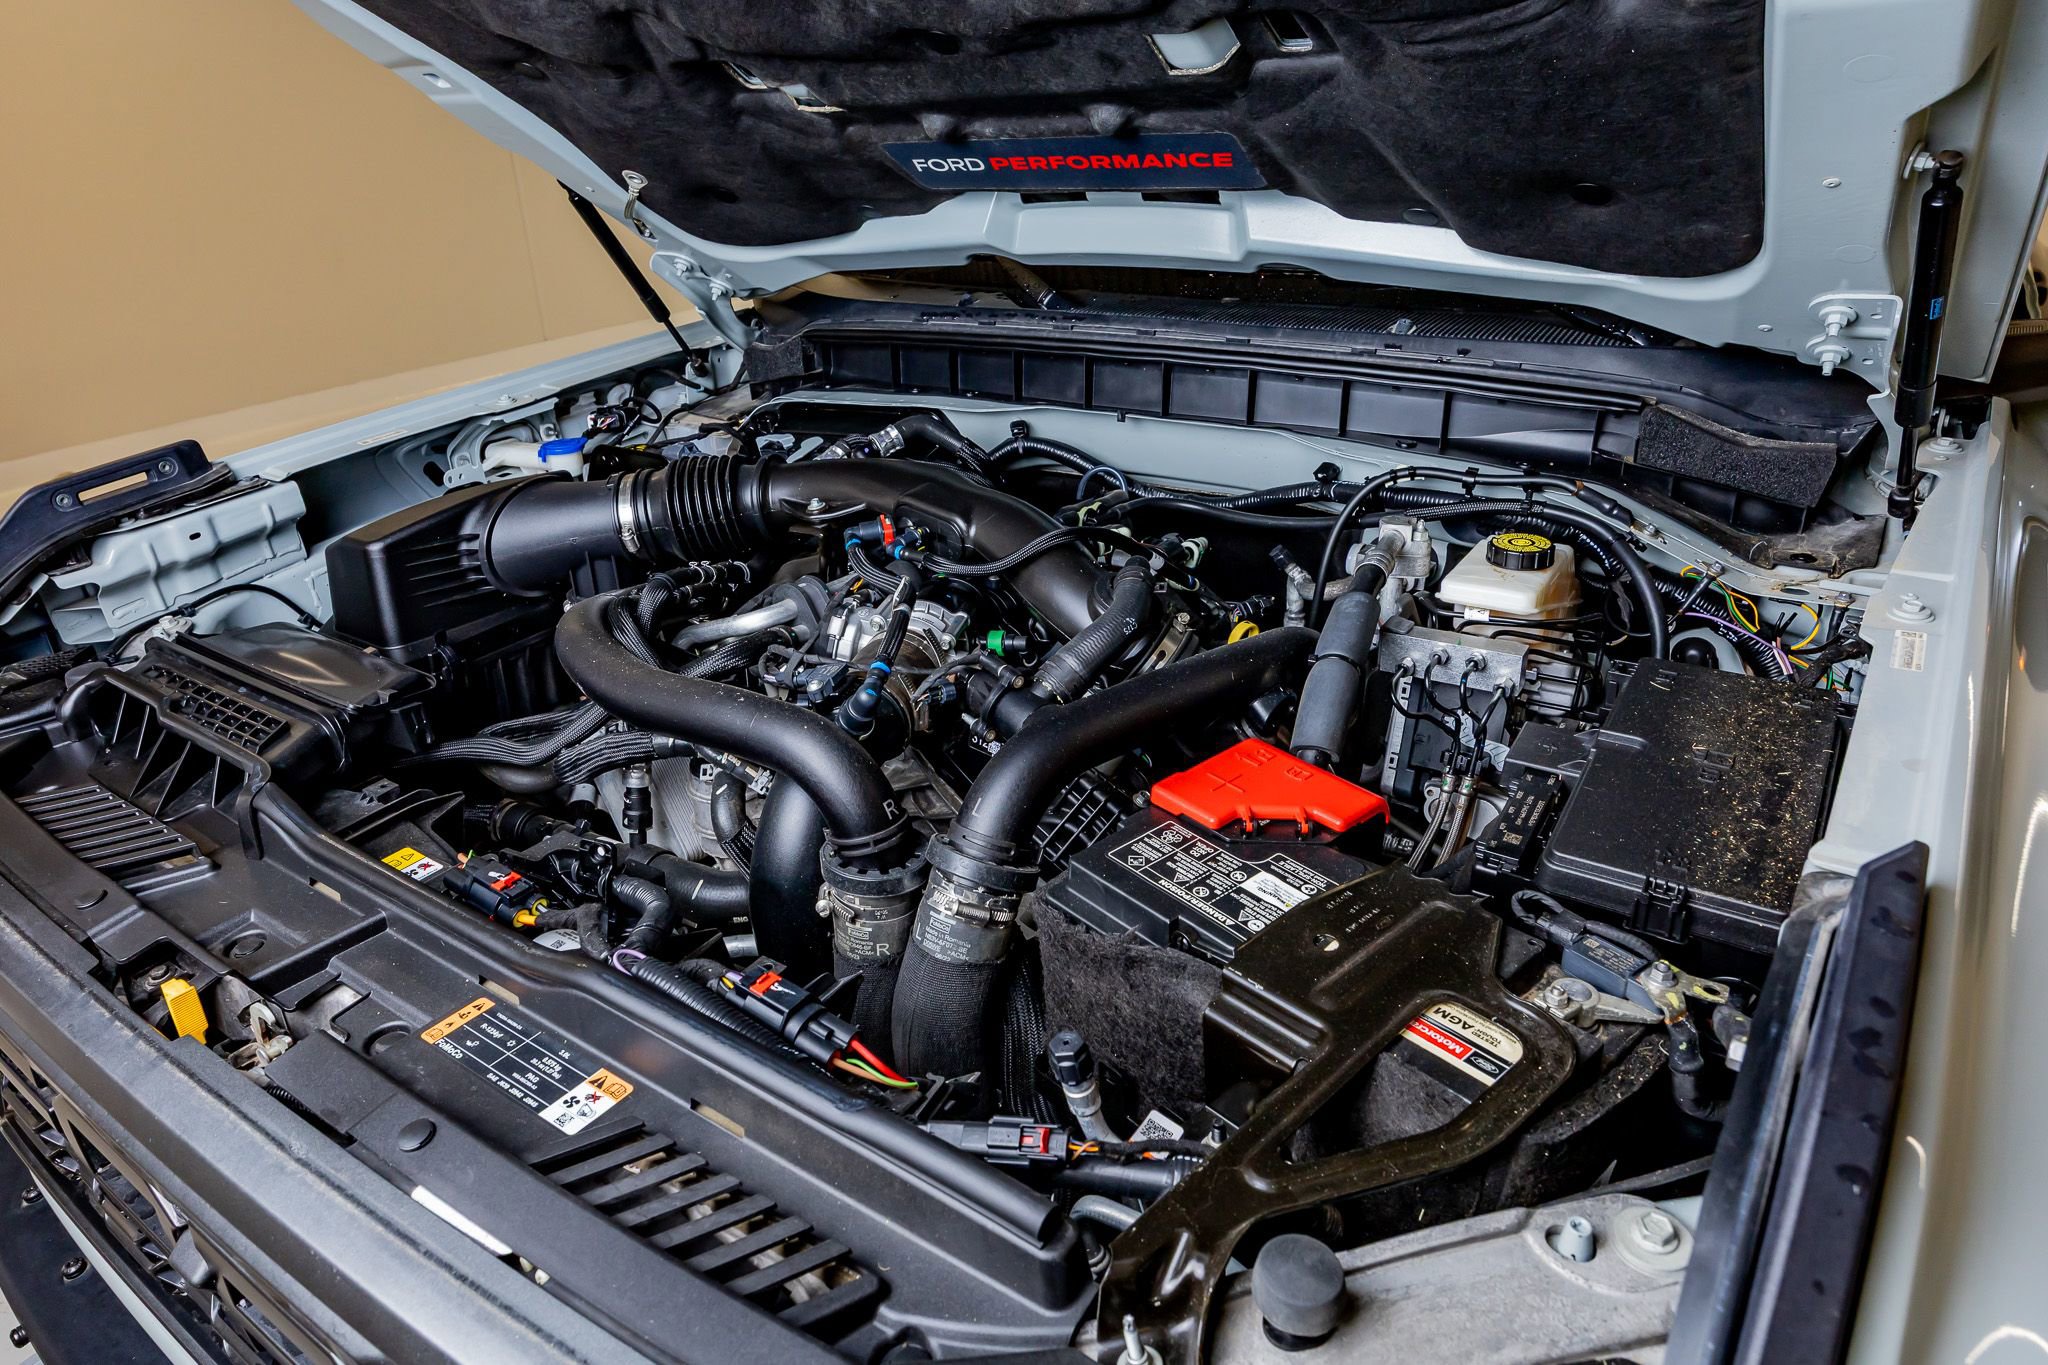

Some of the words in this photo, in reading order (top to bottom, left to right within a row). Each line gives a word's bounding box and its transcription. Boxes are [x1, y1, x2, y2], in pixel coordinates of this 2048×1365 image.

[911, 158, 985, 173] FORD
[990, 152, 1233, 171] PERFORMANCE
[882, 798, 900, 821] R
[971, 797, 981, 817] L
[1192, 846, 1207, 855] NOT
[1158, 879, 1227, 922] DANGER/POISON
[915, 922, 922, 941] L
[876, 943, 891, 956] R
[1433, 1007, 1475, 1030] AGM
[1471, 1031, 1498, 1047] TESTED
[435, 1039, 463, 1059] FoMoCo
[487, 1073, 499, 1082] SAE
[525, 1072, 539, 1083] PAG
